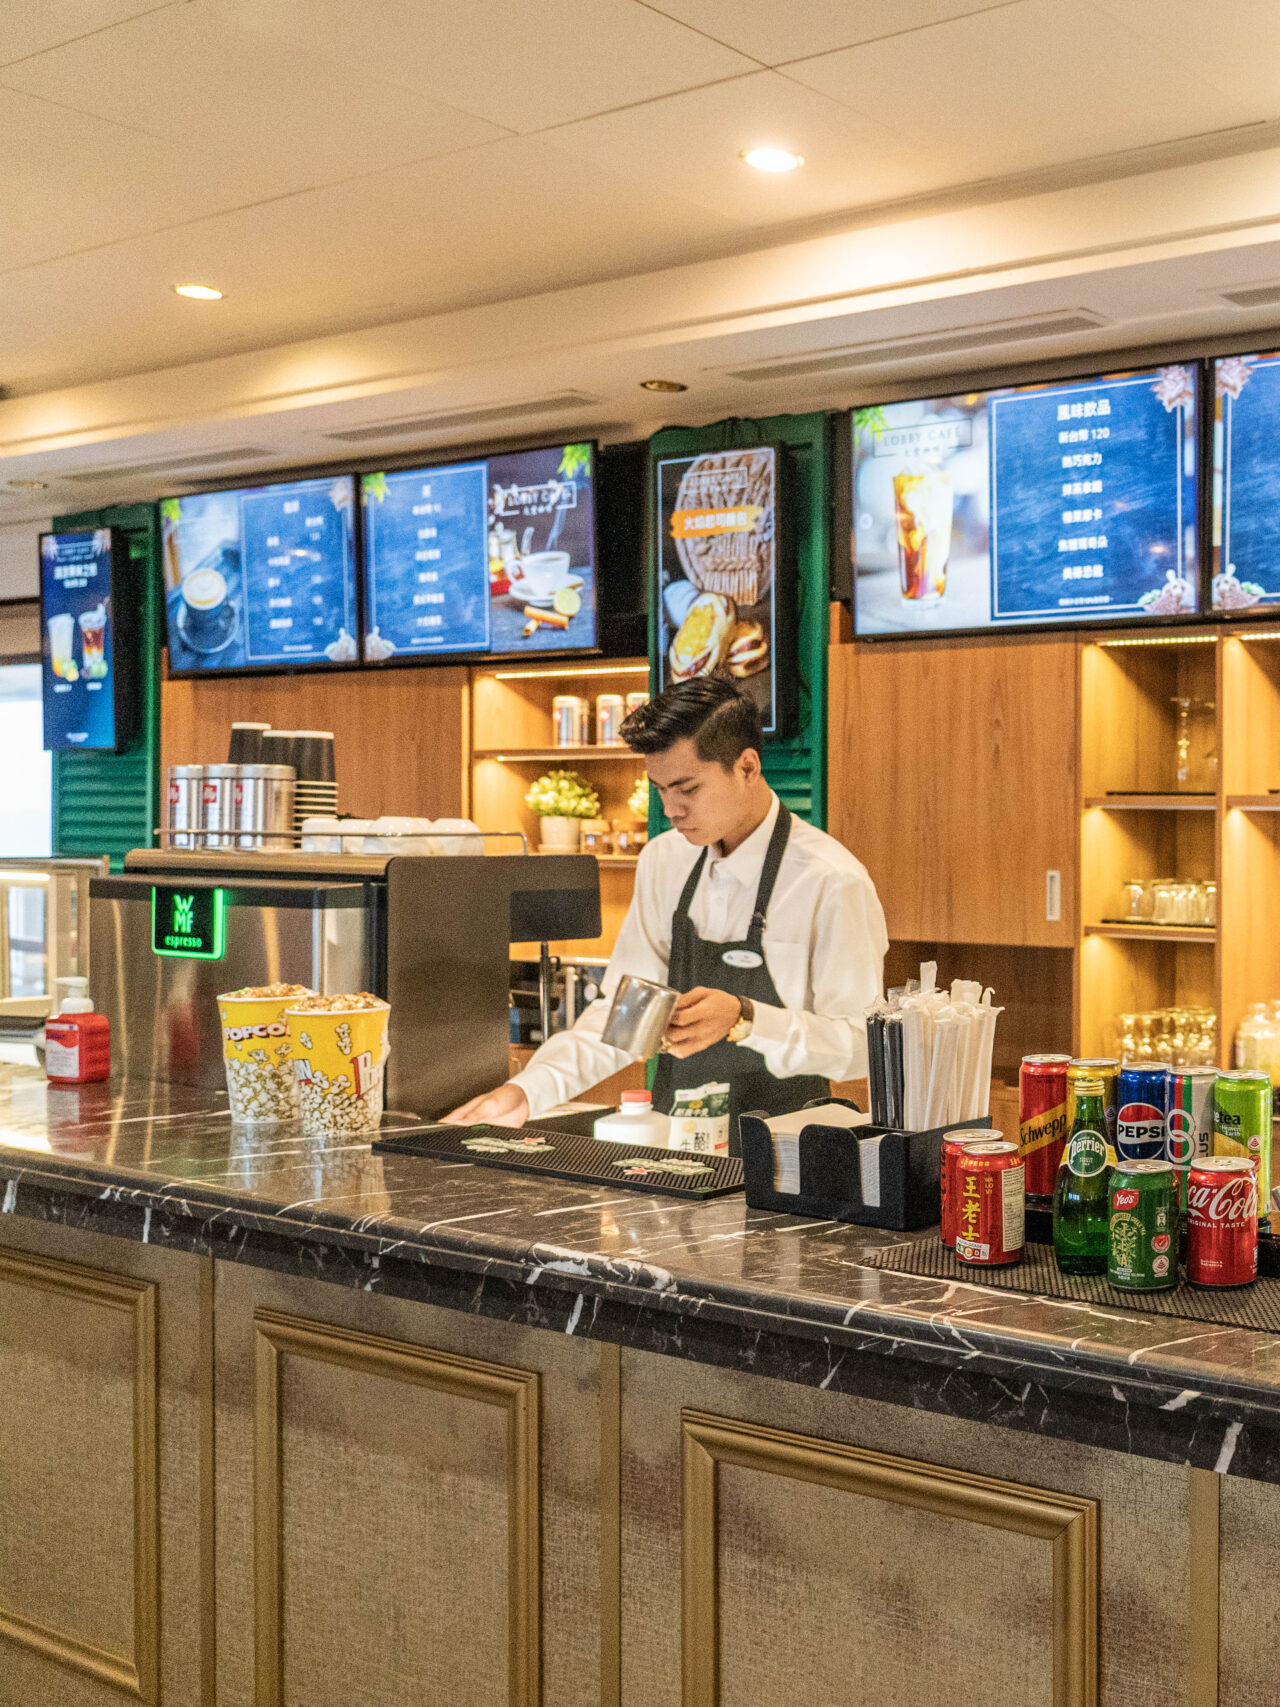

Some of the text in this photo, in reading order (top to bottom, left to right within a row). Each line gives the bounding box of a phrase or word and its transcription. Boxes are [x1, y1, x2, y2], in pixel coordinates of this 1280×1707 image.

[882, 429, 922, 447] LOBBY
[1091, 427, 1110, 440] 120
[164, 935, 202, 949] espresso
[224, 1021, 290, 1042] POPCO
[1019, 1113, 1067, 1148] Schwepp
[1118, 1125, 1165, 1138] PEPSI
[1116, 1193, 1135, 1207] Yeo's
[1187, 1218, 1246, 1229] RIGINAL TASTE
